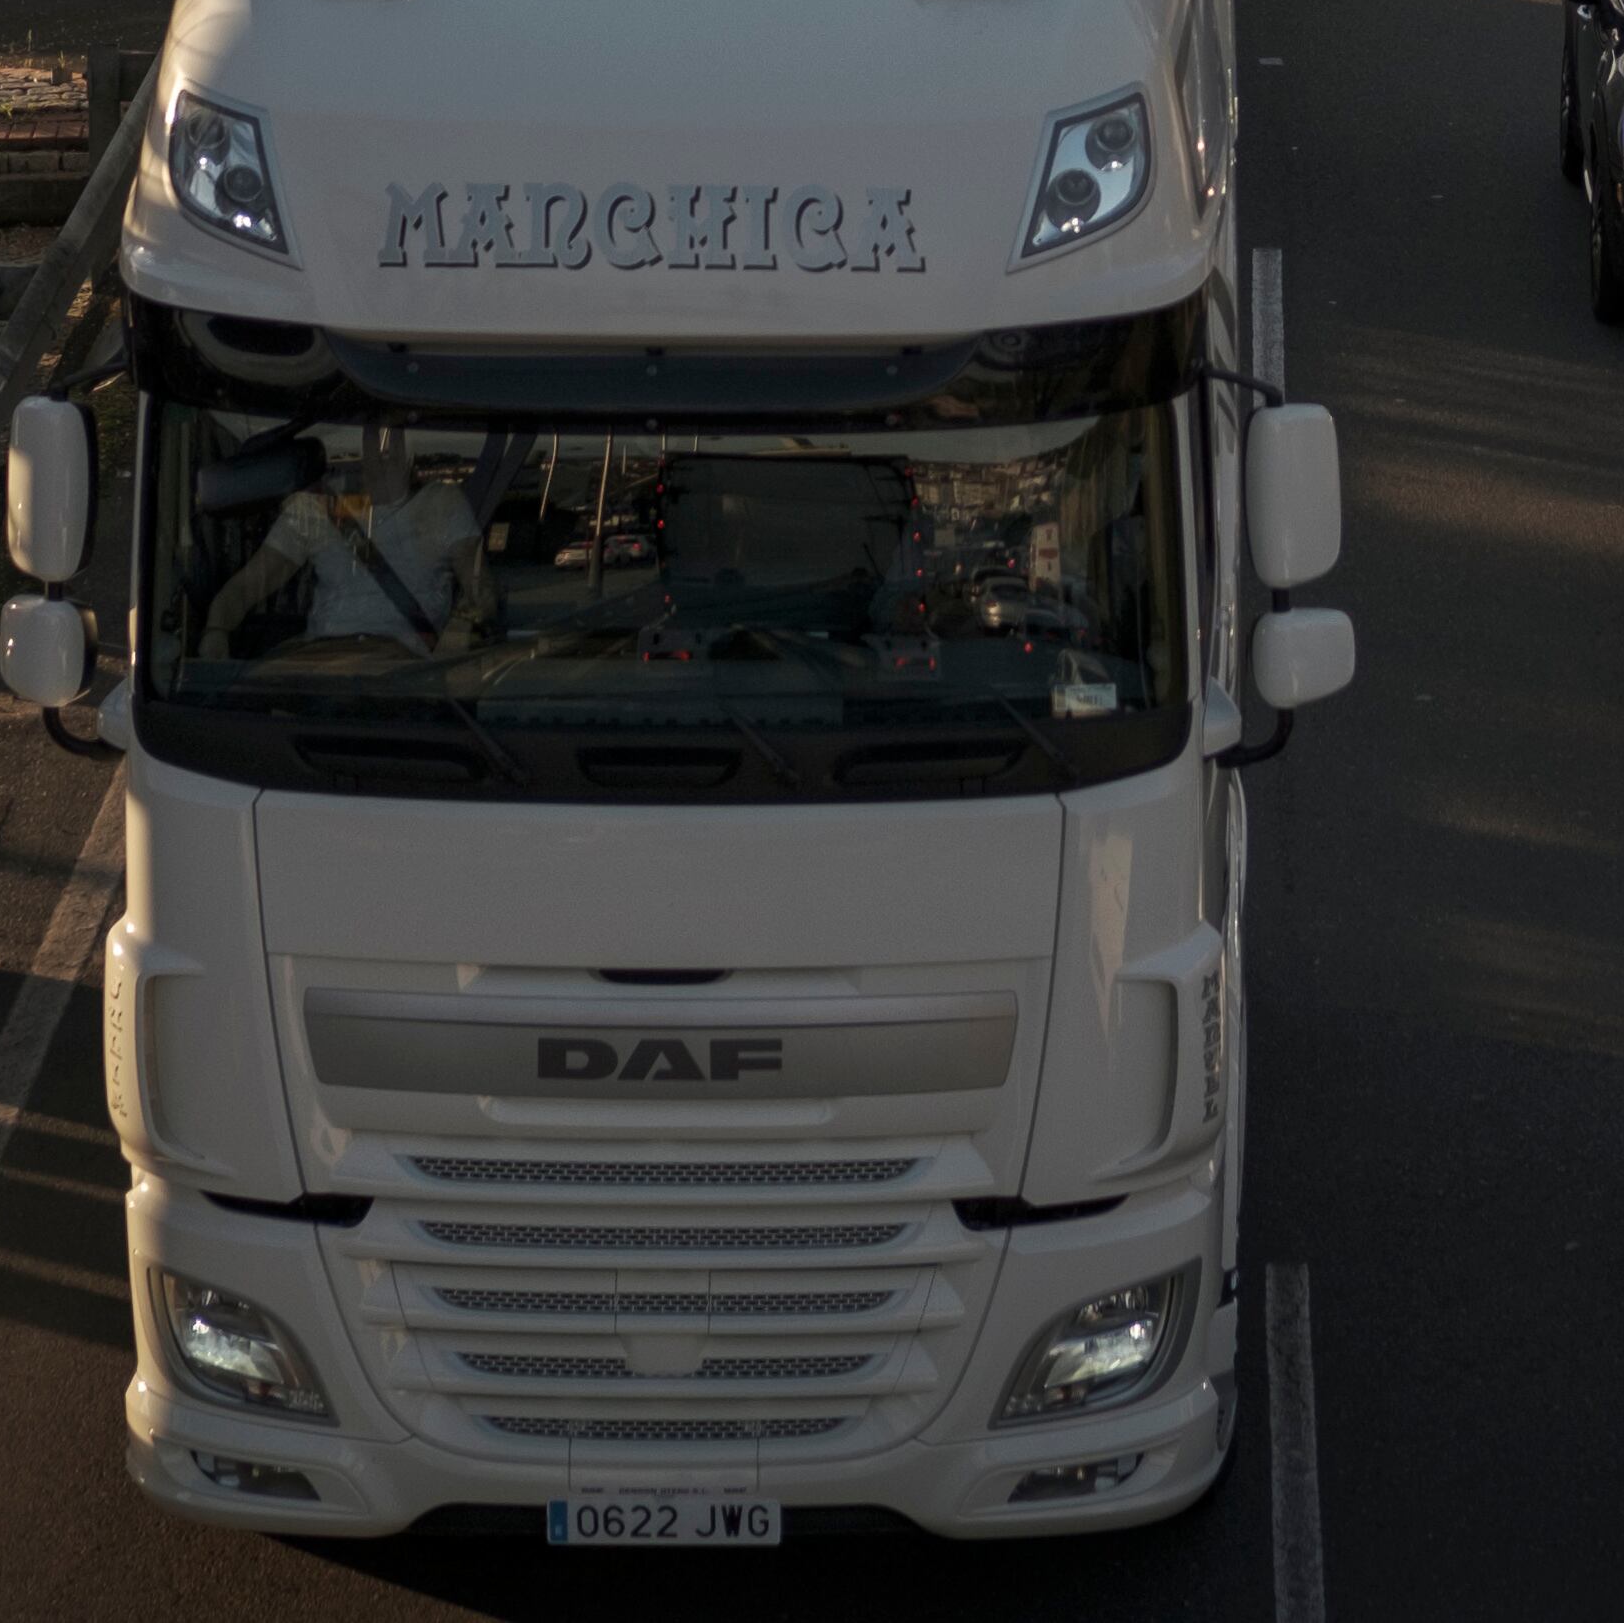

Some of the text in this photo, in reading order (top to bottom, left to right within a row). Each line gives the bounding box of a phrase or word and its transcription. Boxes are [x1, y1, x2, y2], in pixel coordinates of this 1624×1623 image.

[377, 180, 927, 274] MANCHICA
[537, 1037, 783, 1081] DAF
[576, 1504, 770, 1538] 0622 JWG
